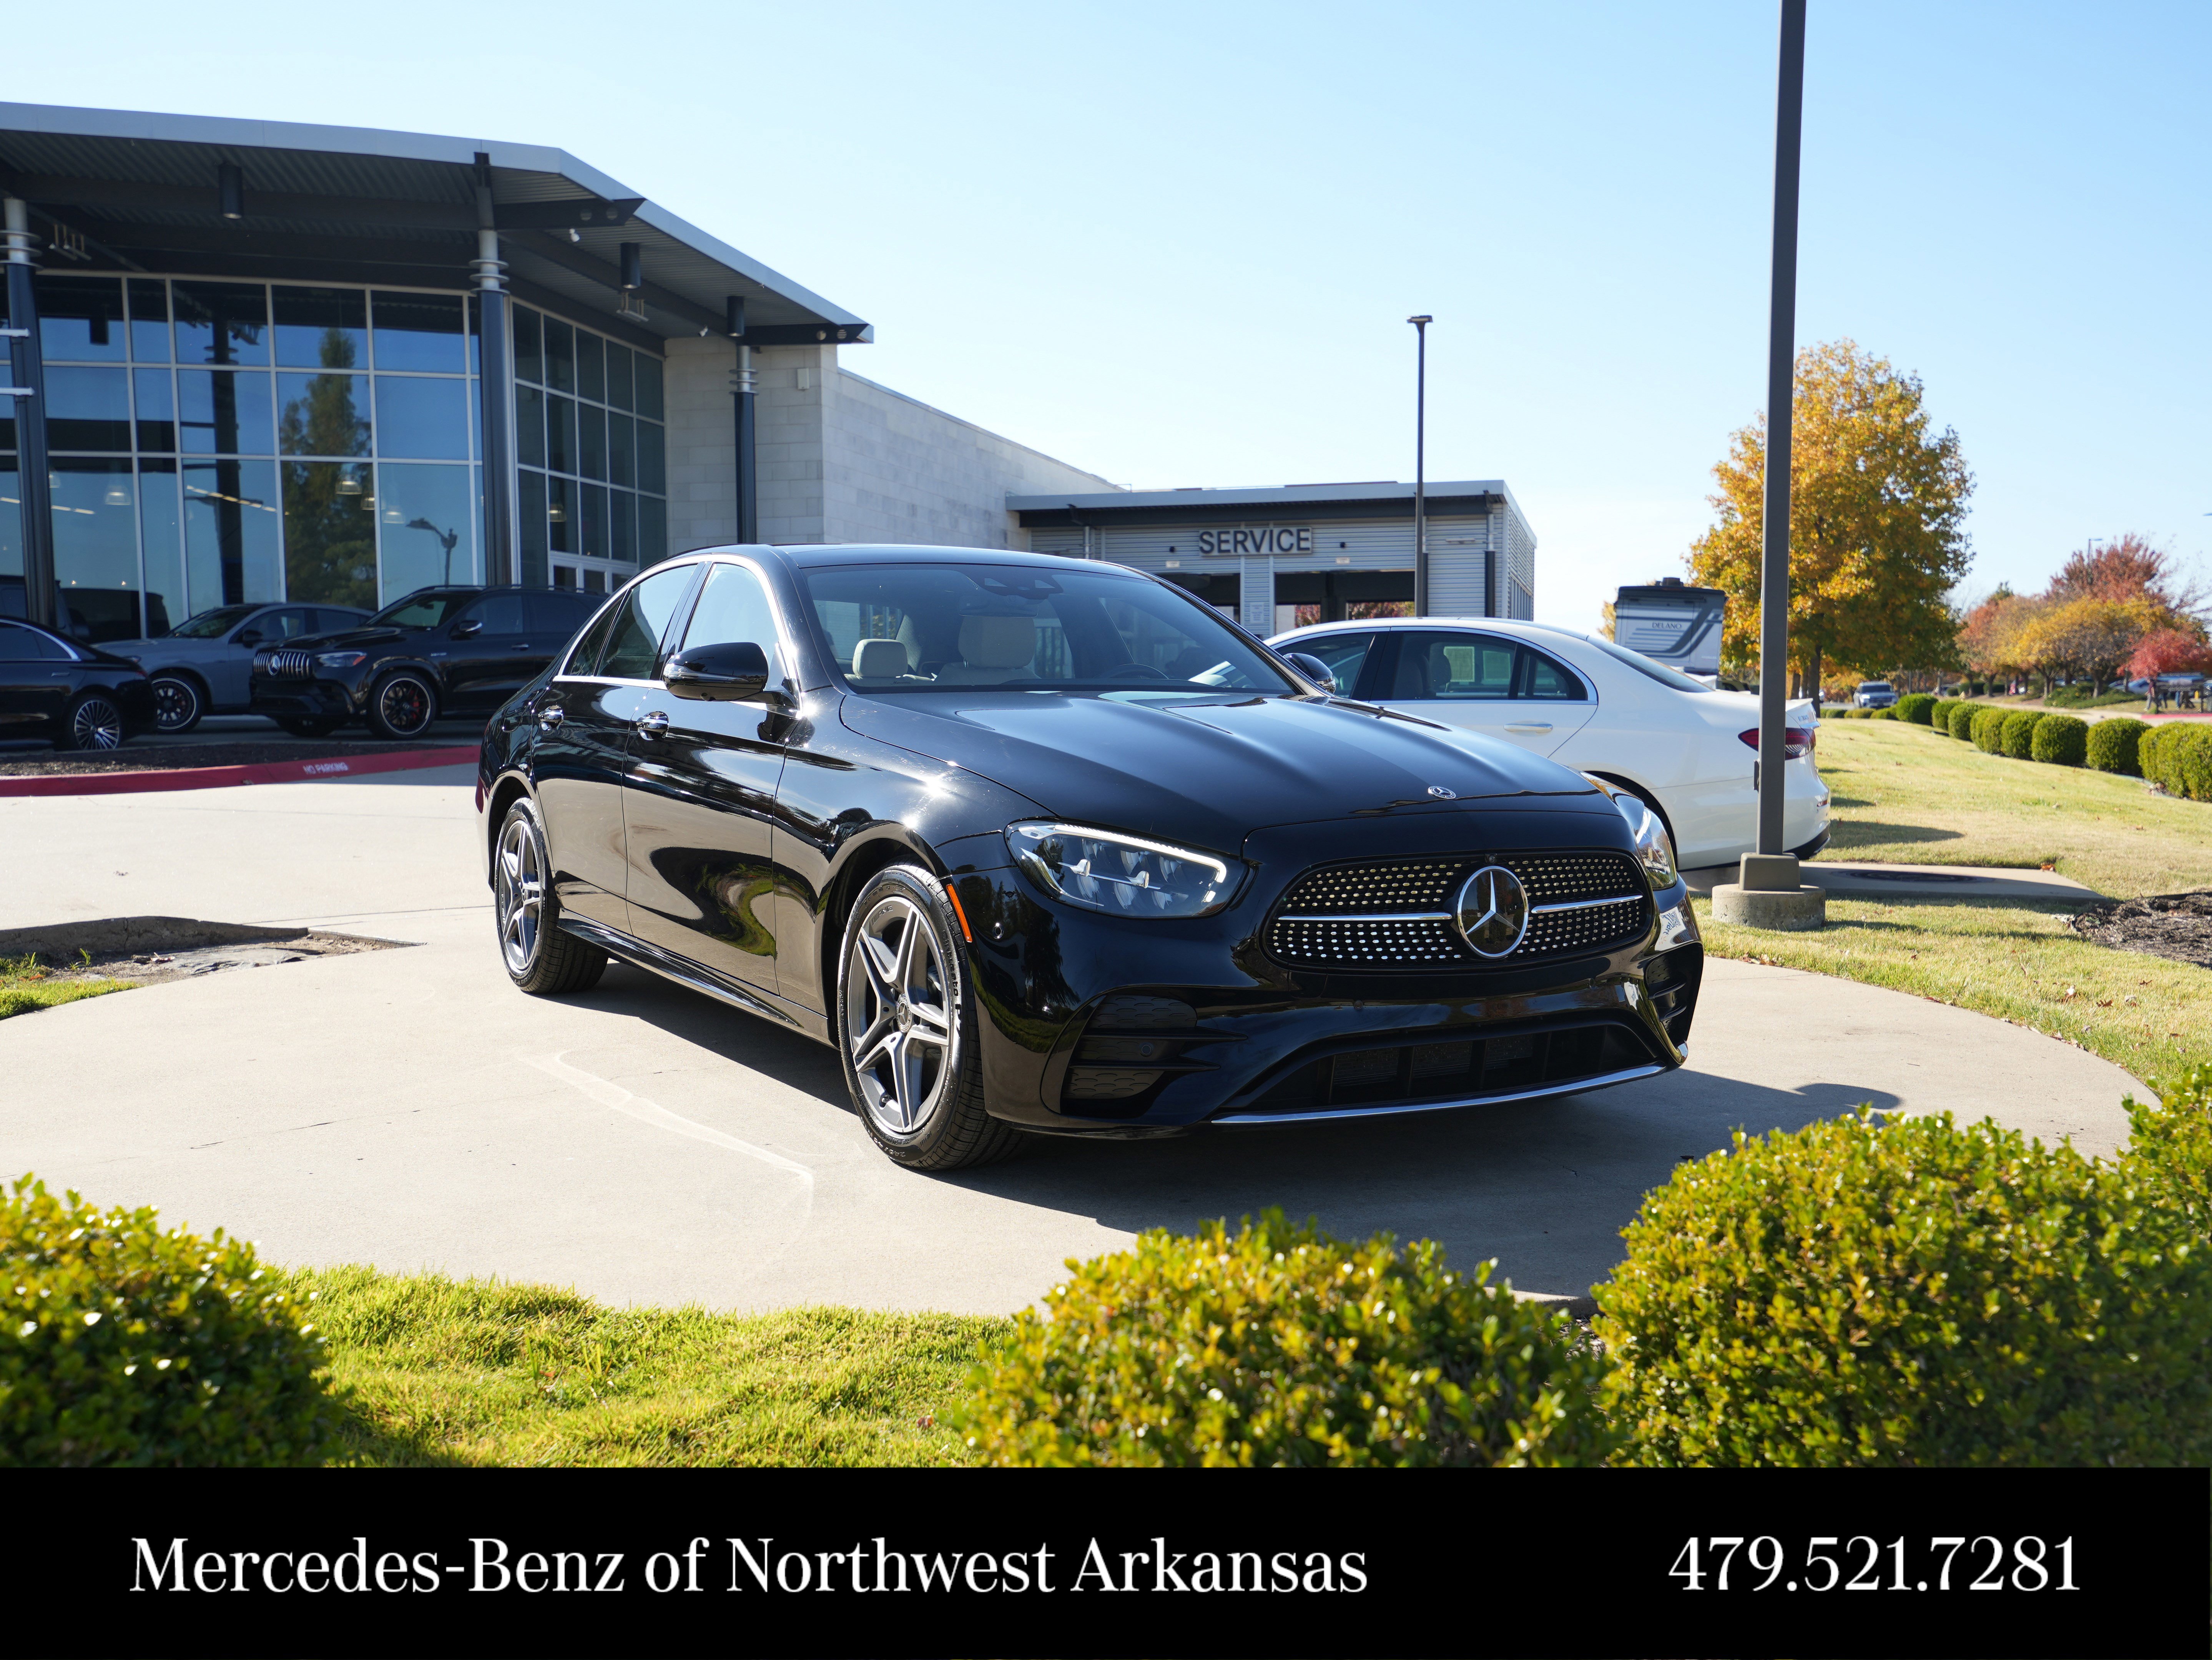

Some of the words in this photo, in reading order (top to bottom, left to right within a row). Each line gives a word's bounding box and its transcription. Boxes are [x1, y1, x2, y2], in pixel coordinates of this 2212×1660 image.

[1199, 528, 1310, 554] SERVICE
[303, 765, 316, 774] NO
[315, 762, 348, 773] PARKING
